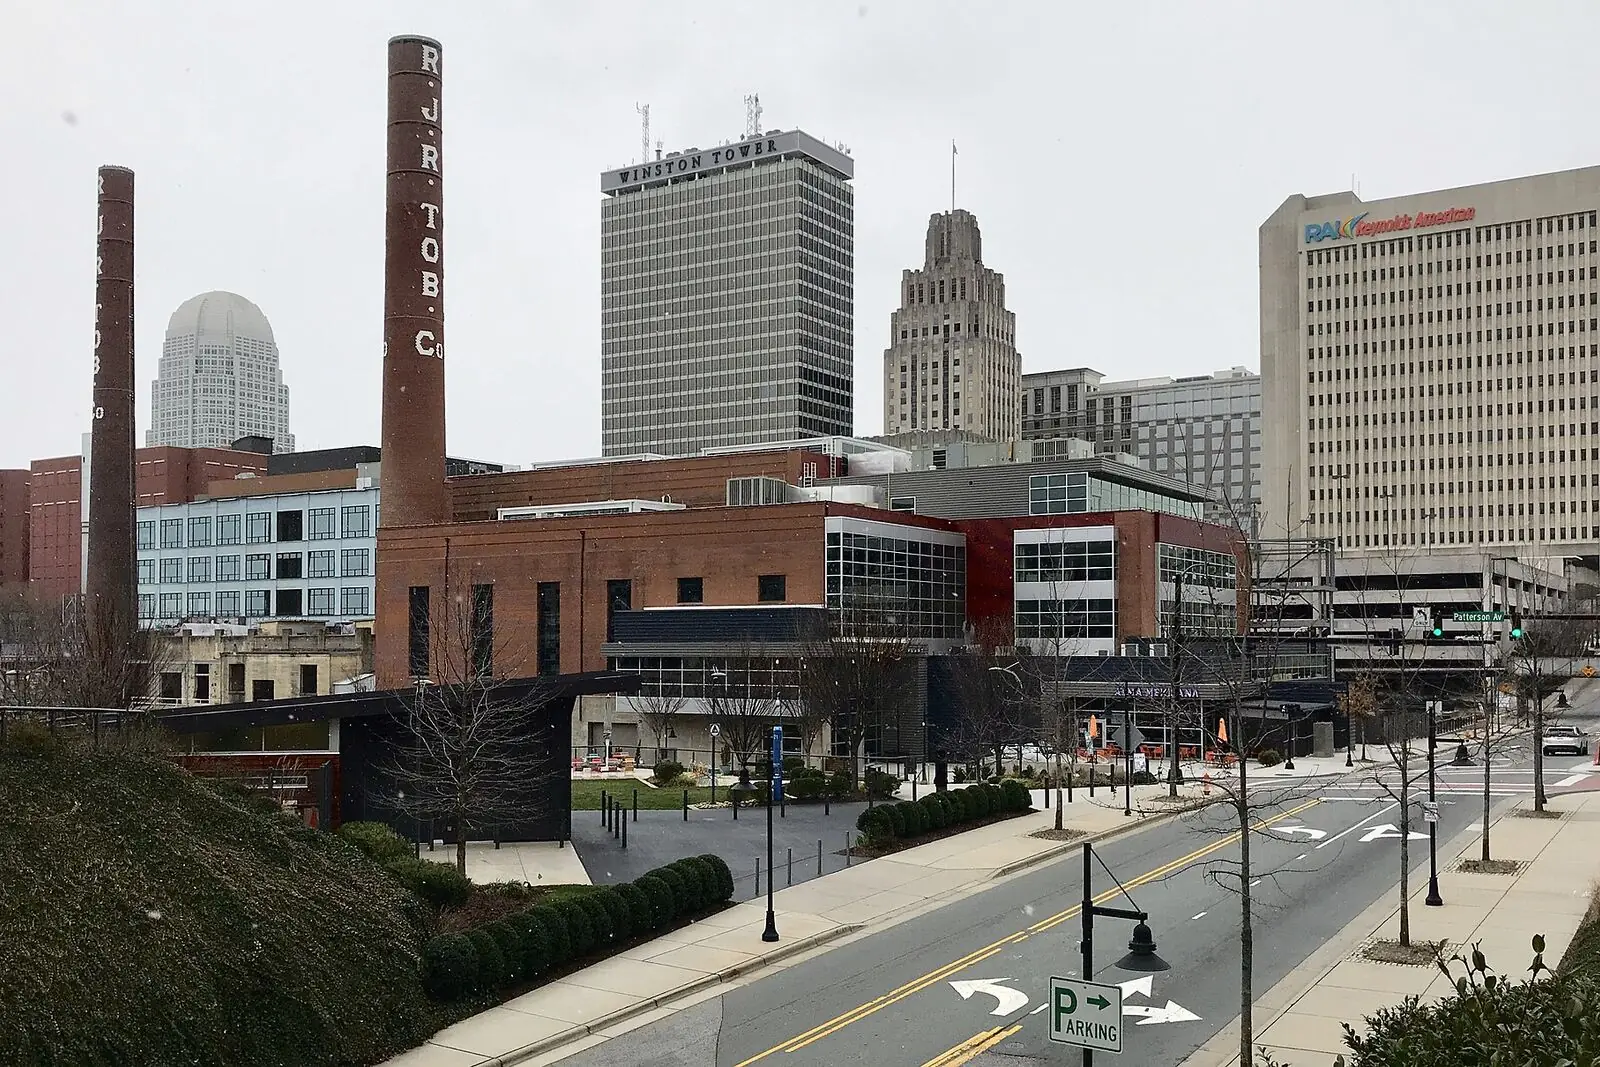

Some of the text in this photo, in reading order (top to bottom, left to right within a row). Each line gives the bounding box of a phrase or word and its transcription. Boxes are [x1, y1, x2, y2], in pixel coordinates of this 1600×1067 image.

[619, 140, 777, 183] WINSTON TOWER
[1304, 207, 1476, 244] RAI Reynolds American
[1453, 612, 1503, 621] Patterson Av
[1144, 687, 1199, 698] MEXIANA
[1055, 986, 1117, 1042] PARKING
